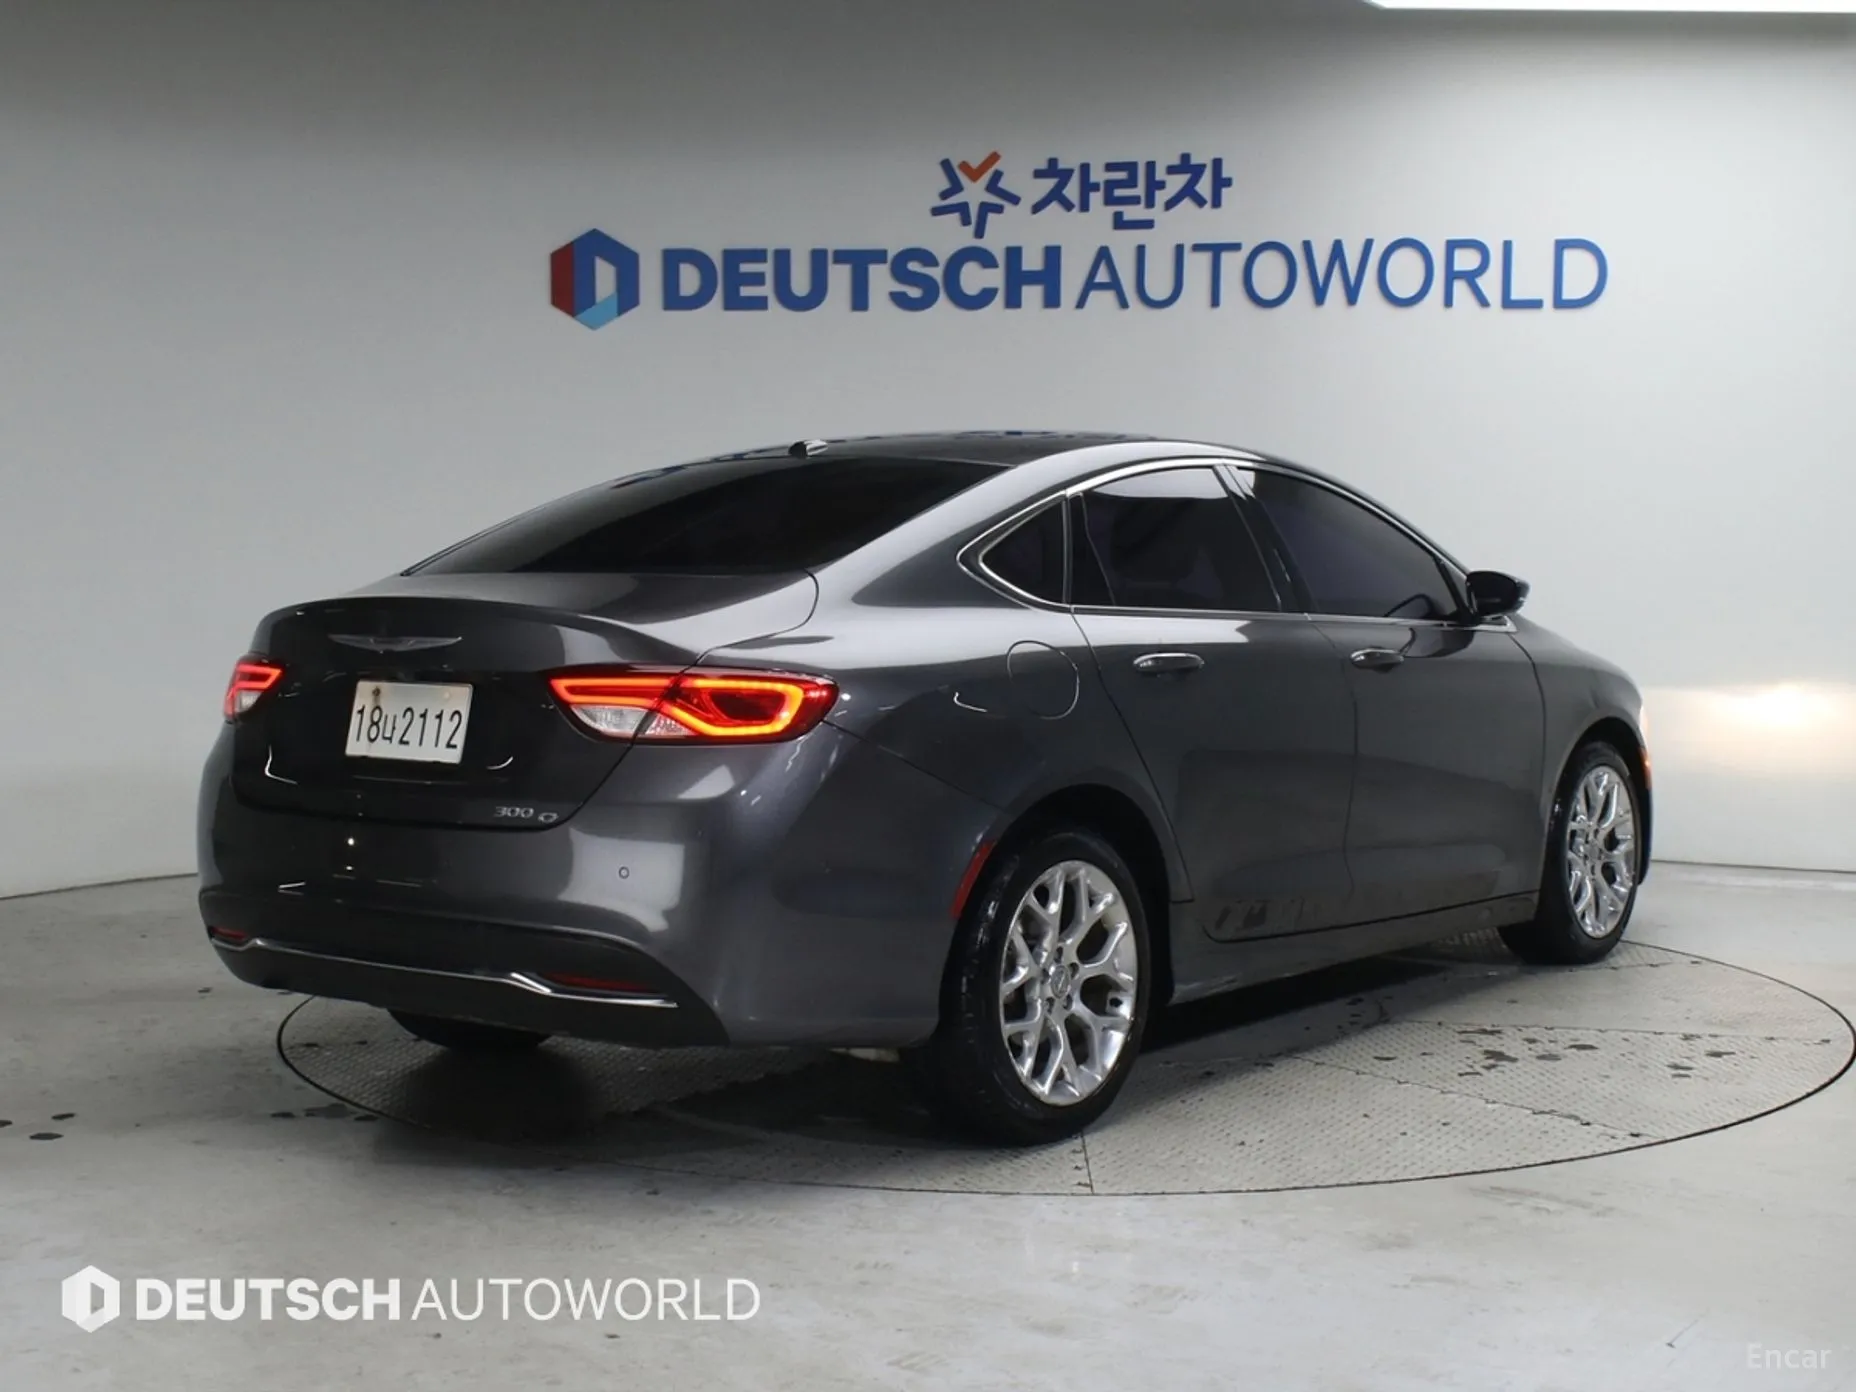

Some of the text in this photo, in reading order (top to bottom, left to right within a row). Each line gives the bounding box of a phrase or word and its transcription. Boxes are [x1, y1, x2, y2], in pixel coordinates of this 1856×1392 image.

[1031, 153, 1233, 230] 차란차
[661, 237, 1608, 312] DEUTSCH AUTOWORLD
